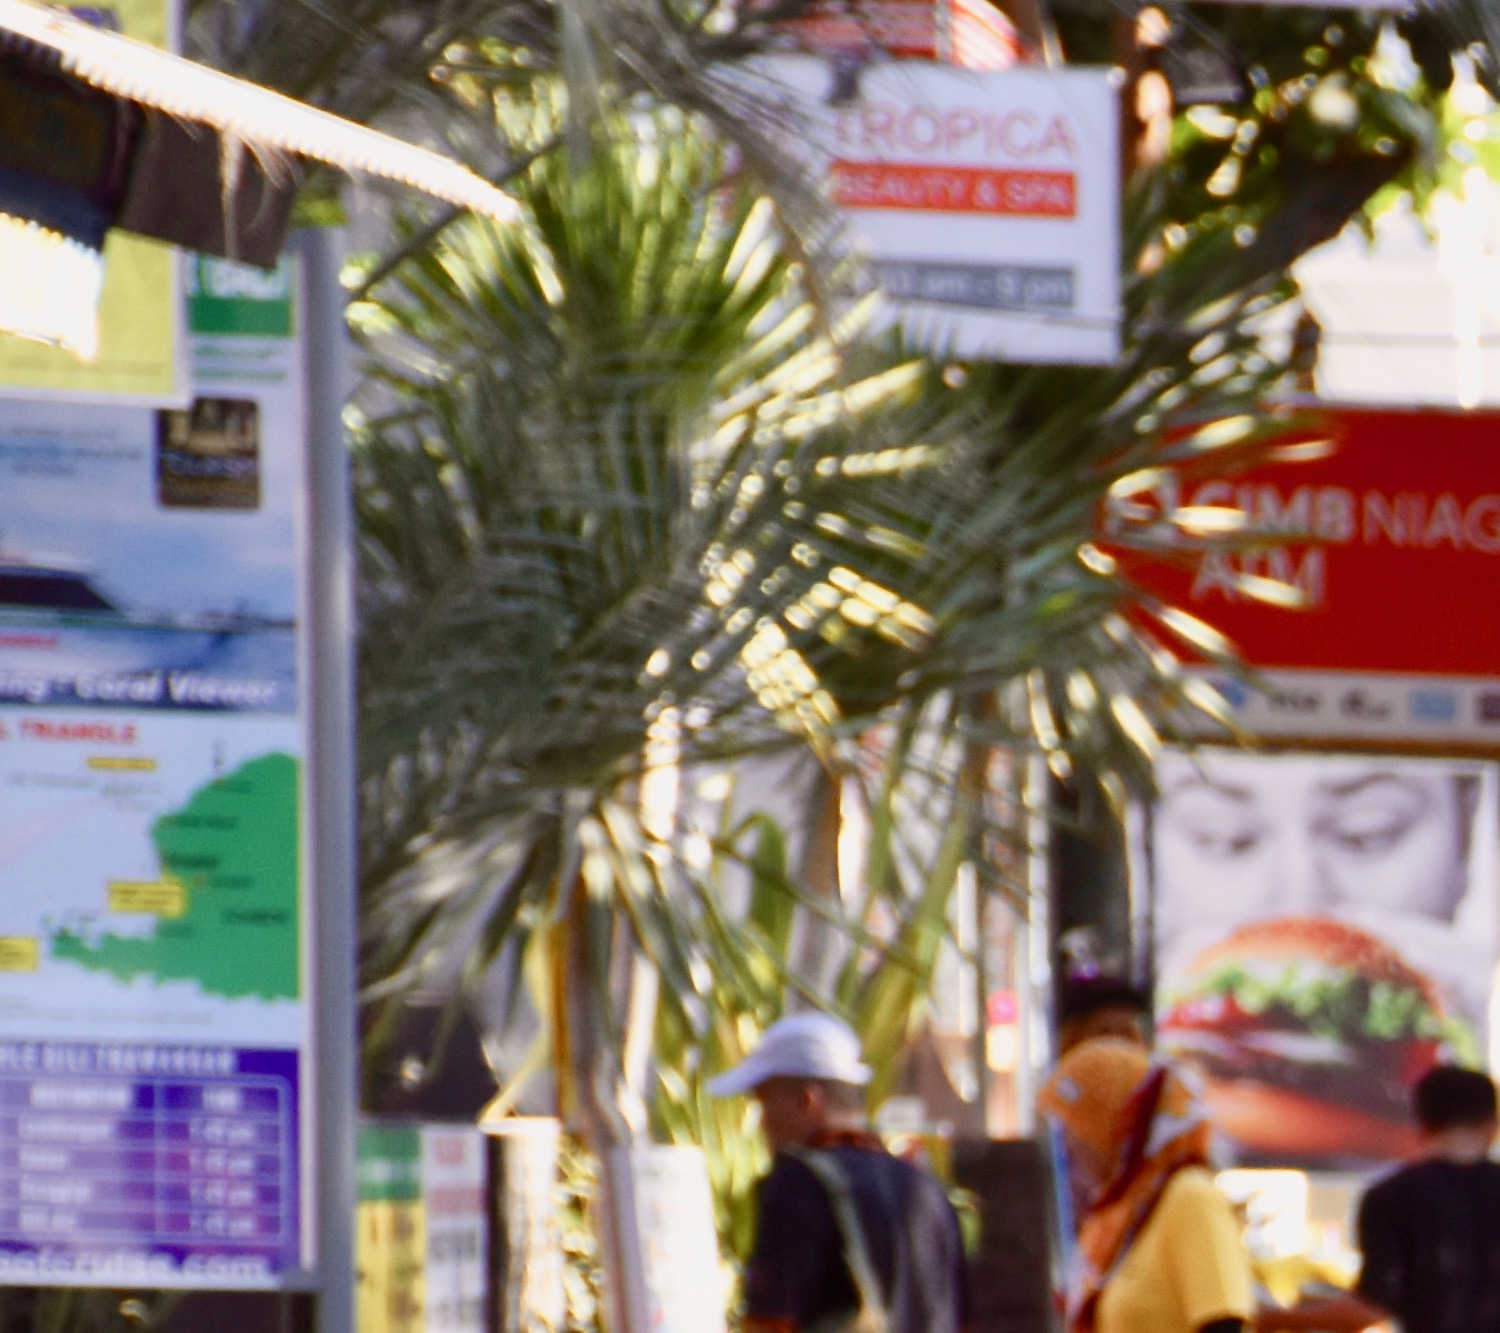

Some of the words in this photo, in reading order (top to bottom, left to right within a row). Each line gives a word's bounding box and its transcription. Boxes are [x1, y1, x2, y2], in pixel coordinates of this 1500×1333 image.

[835, 104, 1079, 157] TROPICA
[1006, 179, 1071, 210] SPA
[74, 672, 160, 701] Coral
[167, 673, 278, 703] Viewer
